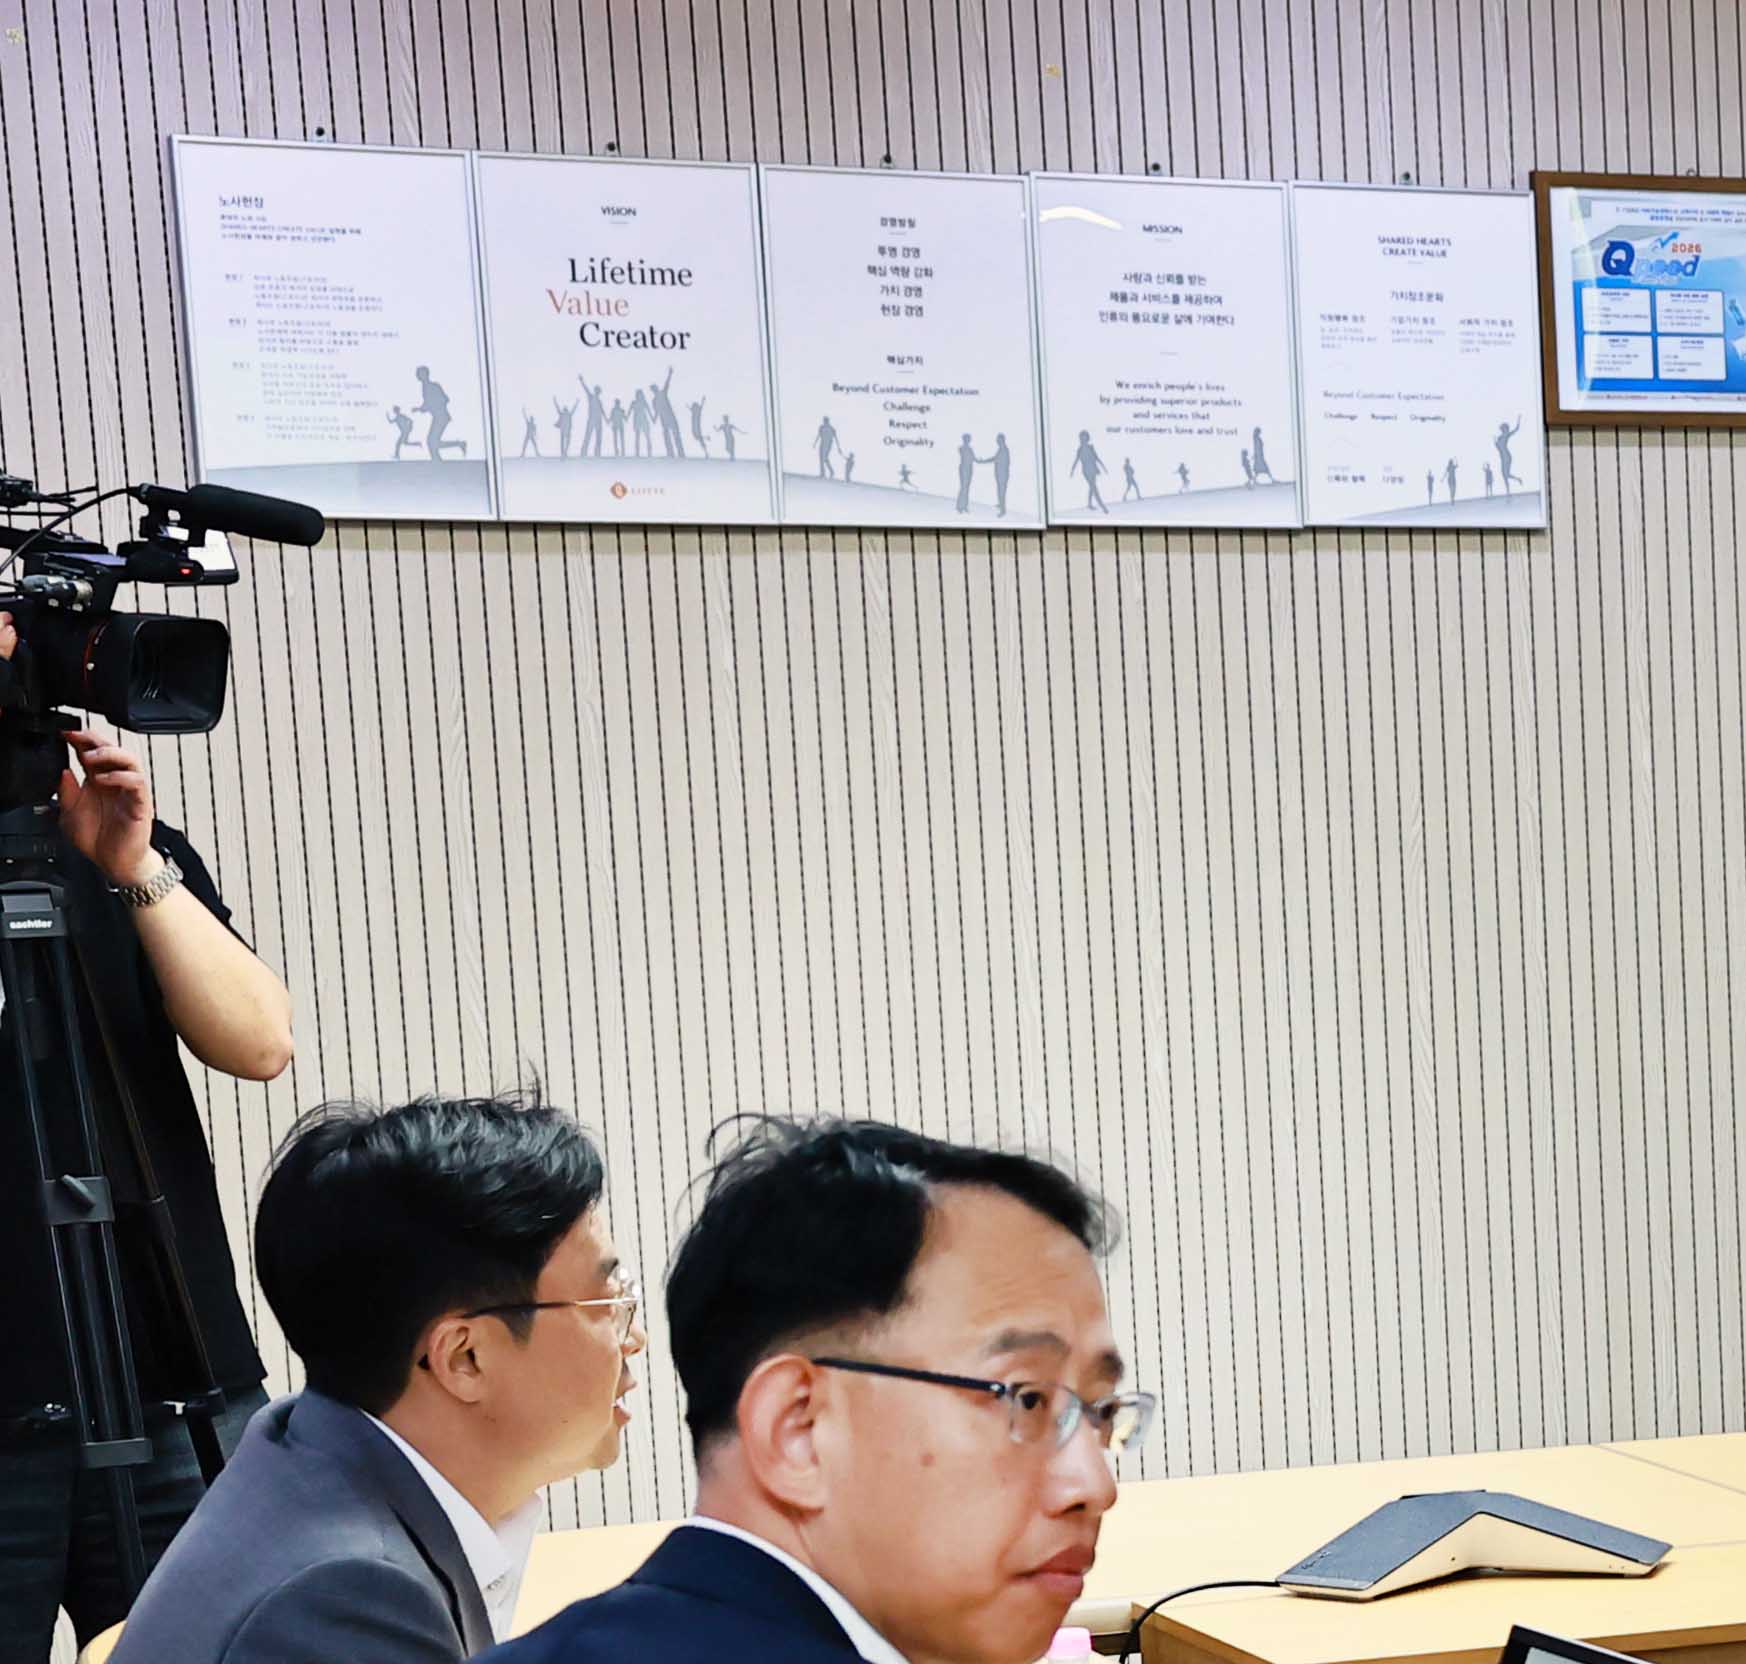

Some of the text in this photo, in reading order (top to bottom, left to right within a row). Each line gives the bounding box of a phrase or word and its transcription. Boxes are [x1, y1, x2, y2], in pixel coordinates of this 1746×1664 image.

[601, 206, 637, 216] VISION
[1142, 224, 1183, 235] MISSION
[1378, 236, 1452, 246] SHARED HEARTS
[902, 247, 921, 259] 경영
[1382, 247, 1447, 258] CREATE VALUE
[568, 257, 693, 287] Lifetime
[867, 265, 887, 277] 핵심
[1123, 272, 1207, 286] 사랑과 신뢰를 받는
[880, 285, 923, 298] 가치 경영
[546, 288, 630, 317] Value
[1142, 292, 1180, 305] 서비스를
[905, 305, 924, 317] 경영
[1132, 312, 1170, 324] 풍요로운
[1174, 313, 1193, 325] 삶에
[579, 322, 691, 350] Creator
[886, 355, 923, 366] 핵심가치
[832, 383, 979, 396] Beyond Customer Expectation
[1115, 380, 1130, 390] We
[1133, 381, 1161, 390] enrich
[1099, 394, 1242, 407] by providing superior products
[883, 401, 931, 414] Challenge
[1133, 409, 1210, 420] and services that
[889, 419, 927, 430] Respect
[1106, 425, 1121, 434] our
[1125, 425, 1172, 434] customers
[1197, 426, 1213, 435] and
[1217, 427, 1238, 436] trust
[883, 436, 934, 448] Originality
[9, 919, 53, 929] sachtler
